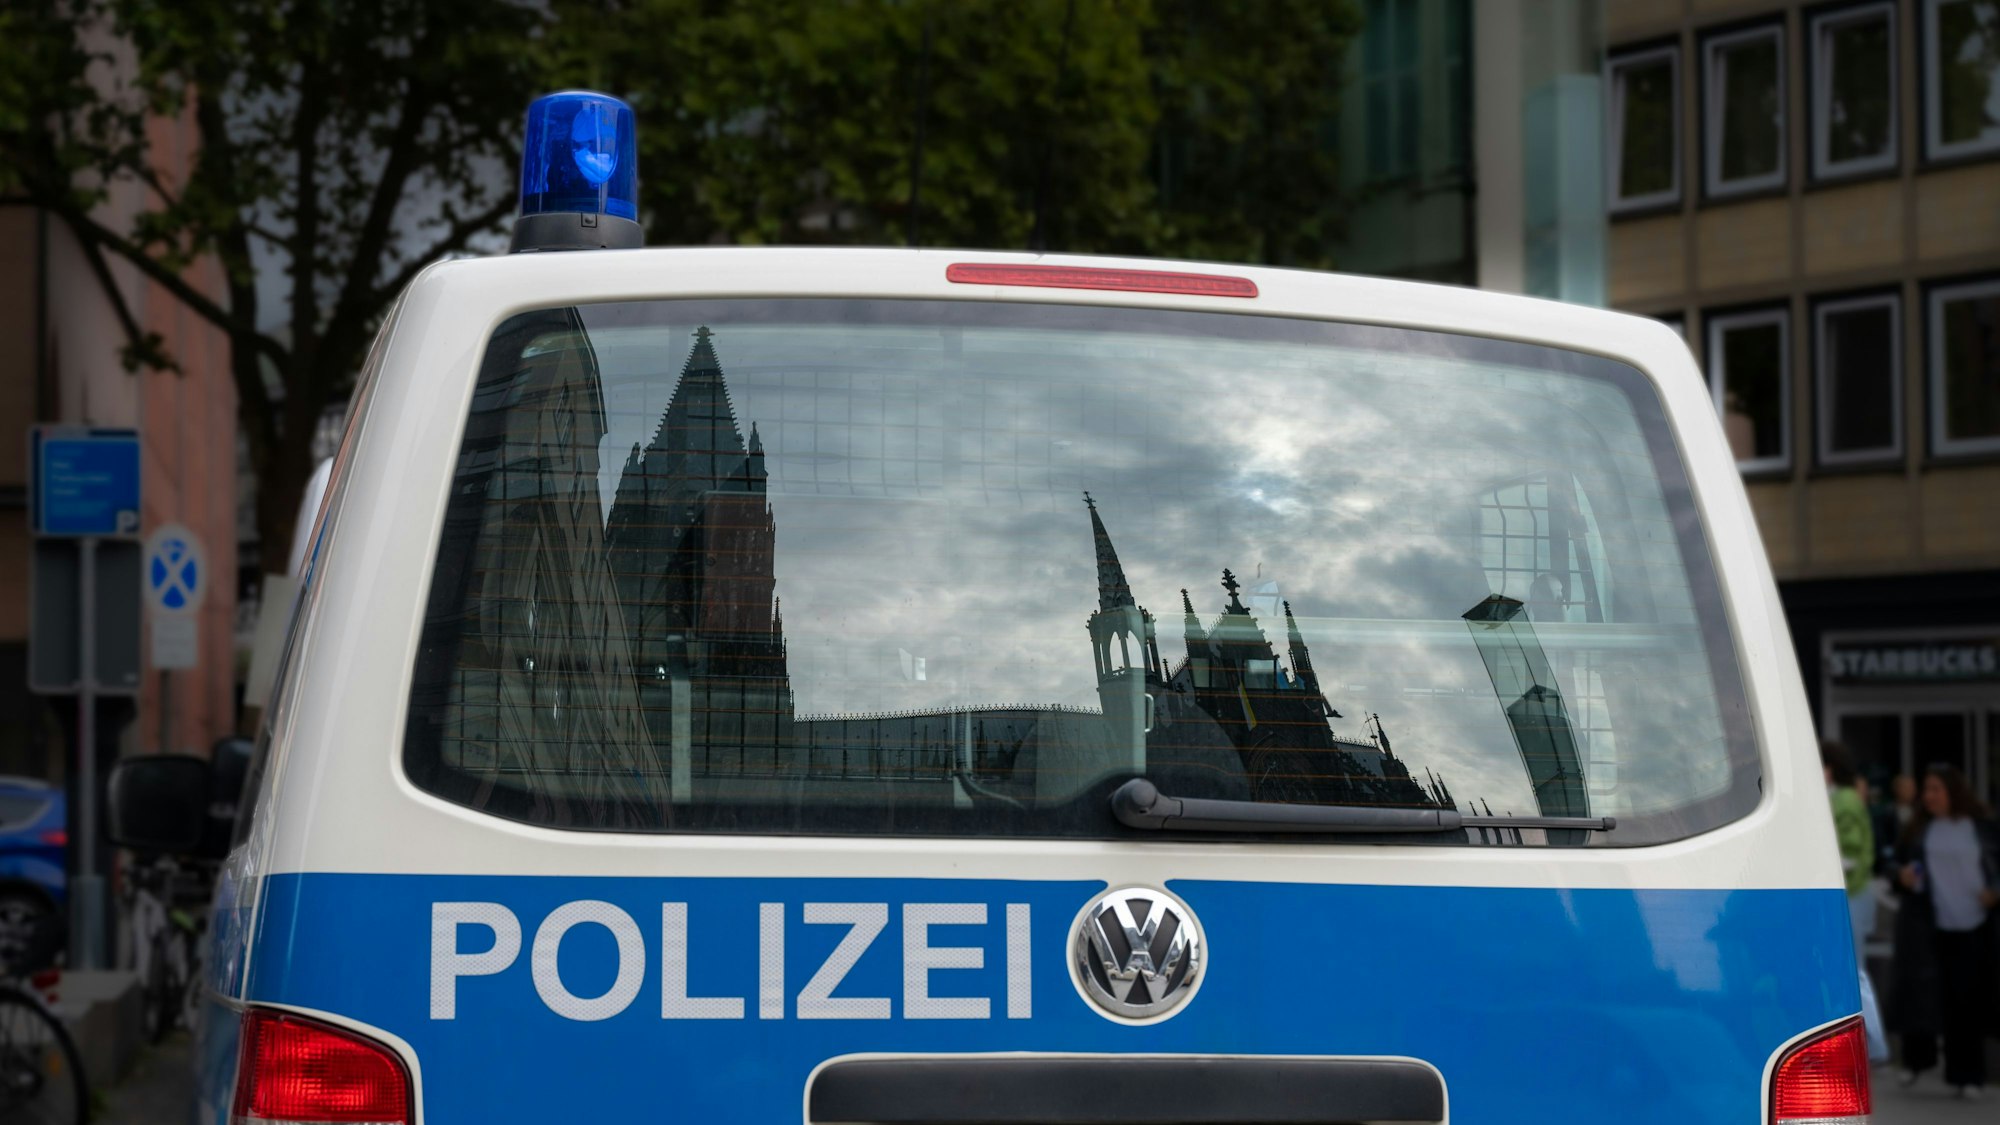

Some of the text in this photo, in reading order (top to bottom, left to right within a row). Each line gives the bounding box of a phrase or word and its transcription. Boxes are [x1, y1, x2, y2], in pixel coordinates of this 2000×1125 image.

[116, 510, 137, 535] P
[1831, 647, 1996, 676] STARBUCKS
[429, 900, 1032, 1021] POLIZEI
[1080, 890, 1200, 1011] VW
